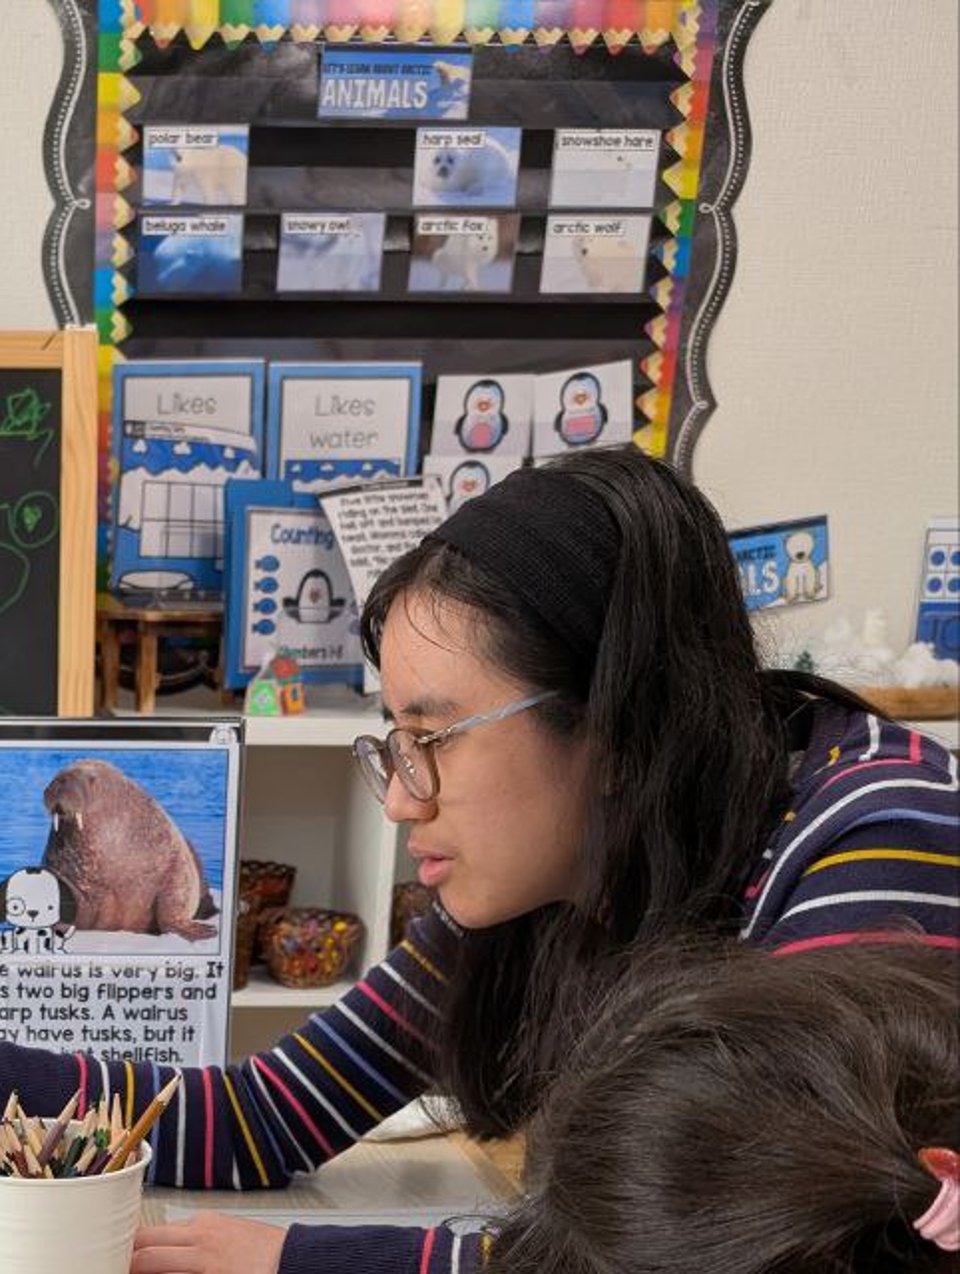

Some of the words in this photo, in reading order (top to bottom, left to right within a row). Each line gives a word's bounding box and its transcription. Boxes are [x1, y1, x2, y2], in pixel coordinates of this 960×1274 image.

[321, 78, 428, 109] ANIMALS
[149, 134, 180, 146] polar
[185, 133, 215, 144] bear
[423, 135, 452, 147] harp
[458, 135, 481, 145] seal
[561, 136, 622, 146] snowshoe
[624, 135, 653, 147] hare
[146, 220, 187, 232] beluga
[190, 219, 225, 231] whale
[422, 221, 459, 231] arctic
[553, 222, 589, 233] arctic
[157, 392, 217, 414] Likes
[314, 394, 376, 416] Likes
[310, 431, 379, 449] water
[271, 523, 336, 551] Counting
[18, 961, 82, 979] walrus
[89, 961, 103, 978] is
[111, 966, 158, 982] very
[165, 961, 199, 982] big.
[206, 961, 224, 978] It
[16, 982, 55, 999] two
[61, 982, 90, 1002] big
[181, 982, 217, 999] and
[40, 1003, 95, 1021] tusks.
[101, 1004, 115, 1020] A
[123, 1004, 188, 1021] walrus
[26, 1025, 74, 1042] have
[81, 1025, 136, 1044] tusks,
[143, 1025, 175, 1042] but
[182, 1025, 195, 1042] it
